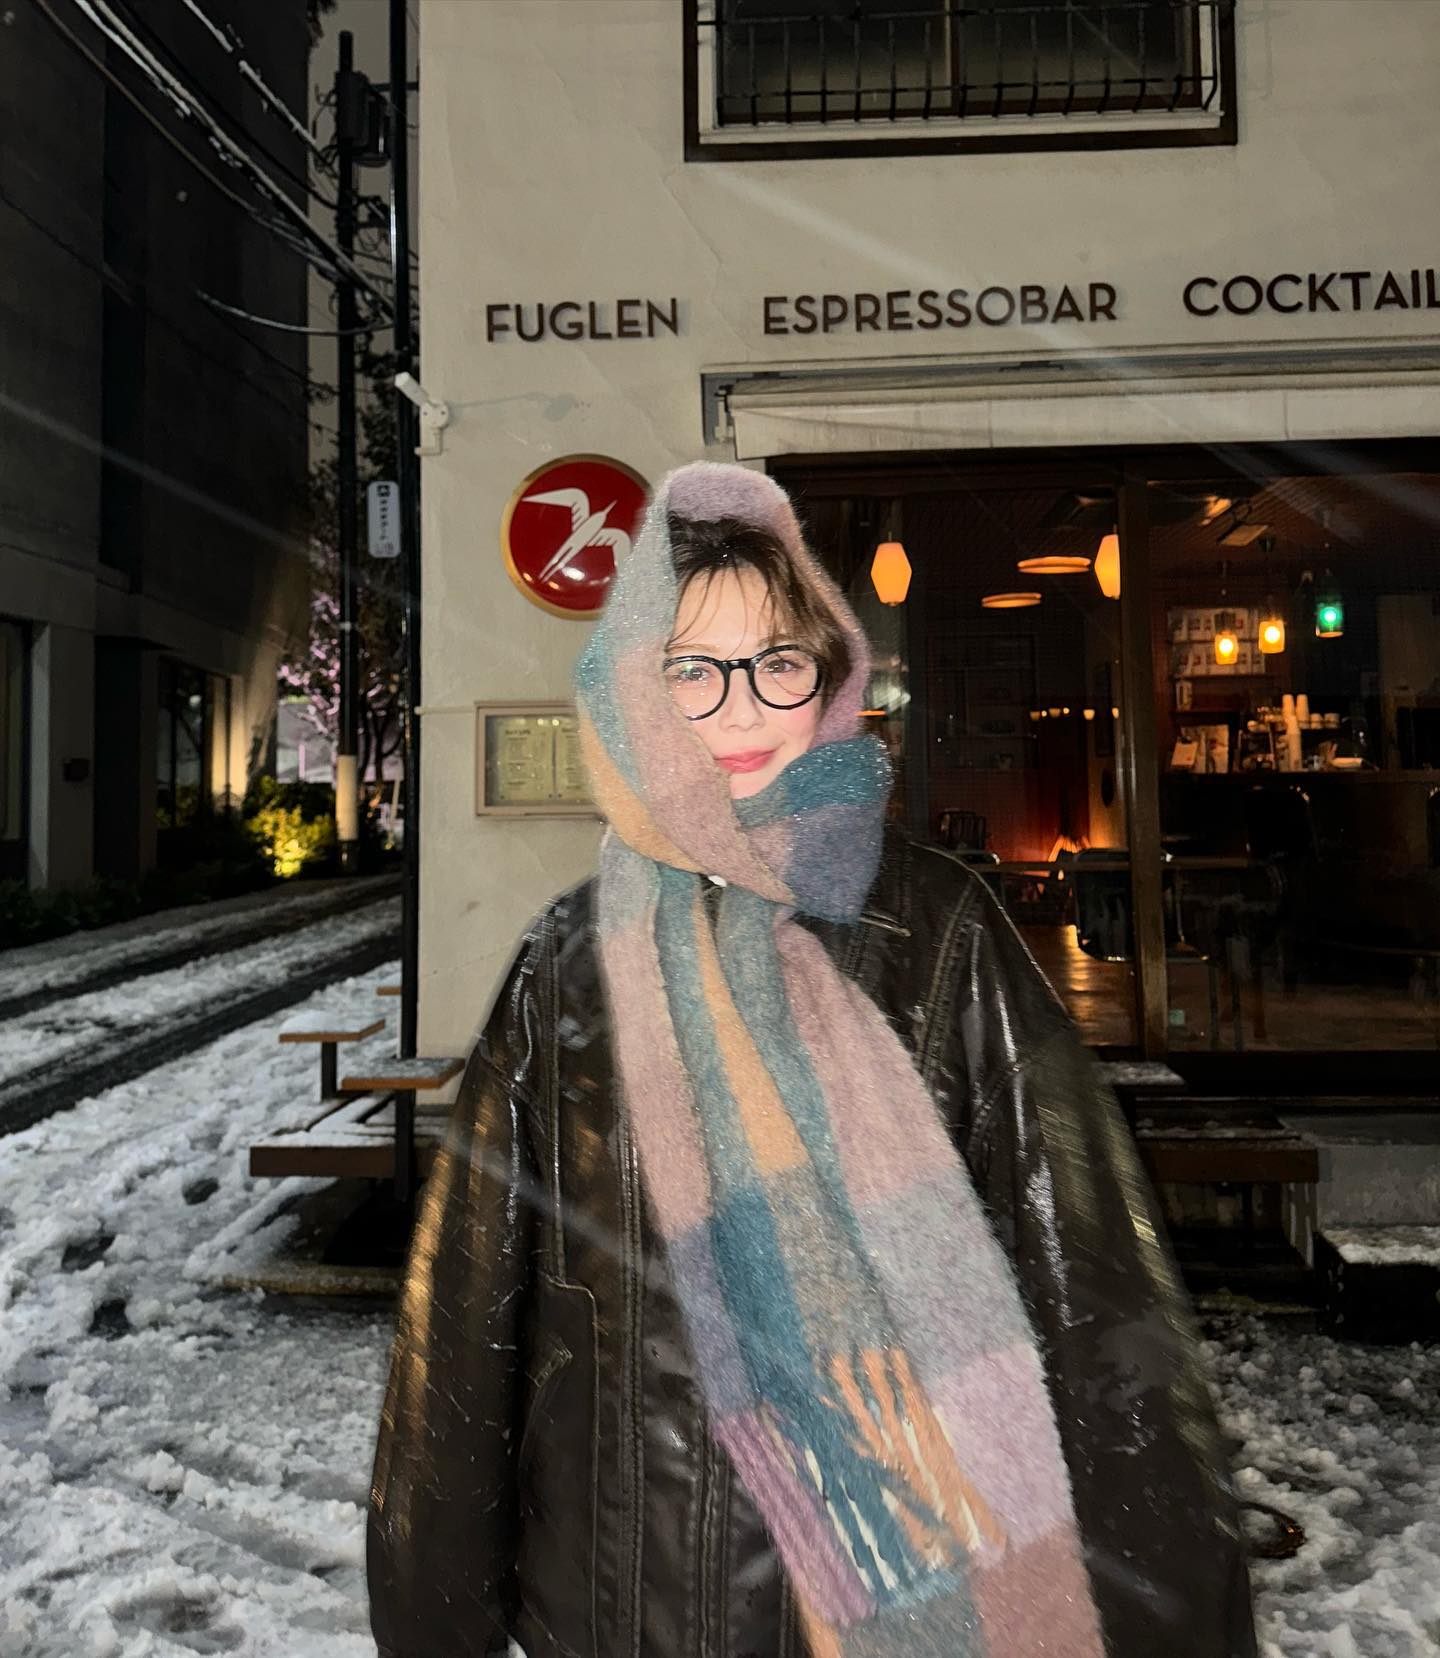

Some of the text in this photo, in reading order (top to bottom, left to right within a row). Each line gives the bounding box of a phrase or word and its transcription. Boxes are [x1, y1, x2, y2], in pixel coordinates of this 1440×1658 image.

[485, 269, 1440, 342] FUGLEN ESPRESSOBAR COCKTAIL
